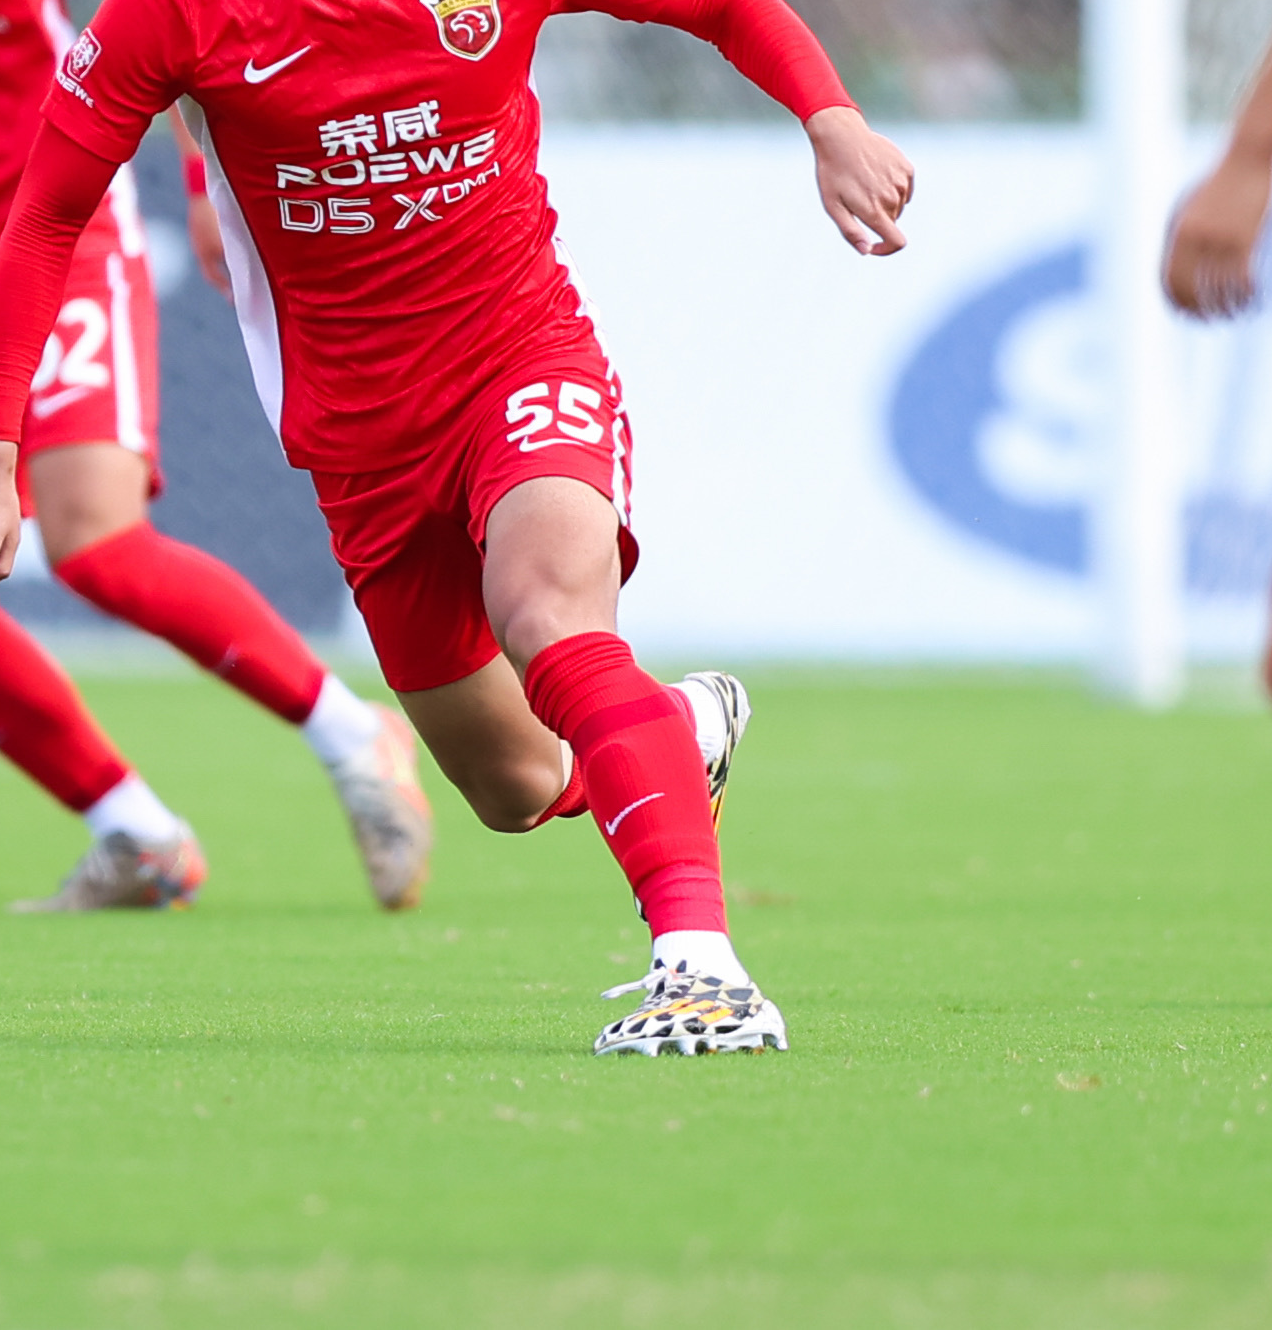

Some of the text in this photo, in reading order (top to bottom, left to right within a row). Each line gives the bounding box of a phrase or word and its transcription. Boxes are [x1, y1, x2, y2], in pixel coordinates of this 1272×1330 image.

[55, 69, 95, 108] OEWE
[318, 99, 442, 157] 荣威
[275, 128, 497, 189] ROEWE
[278, 196, 376, 235] D5
[505, 381, 605, 445] 55
